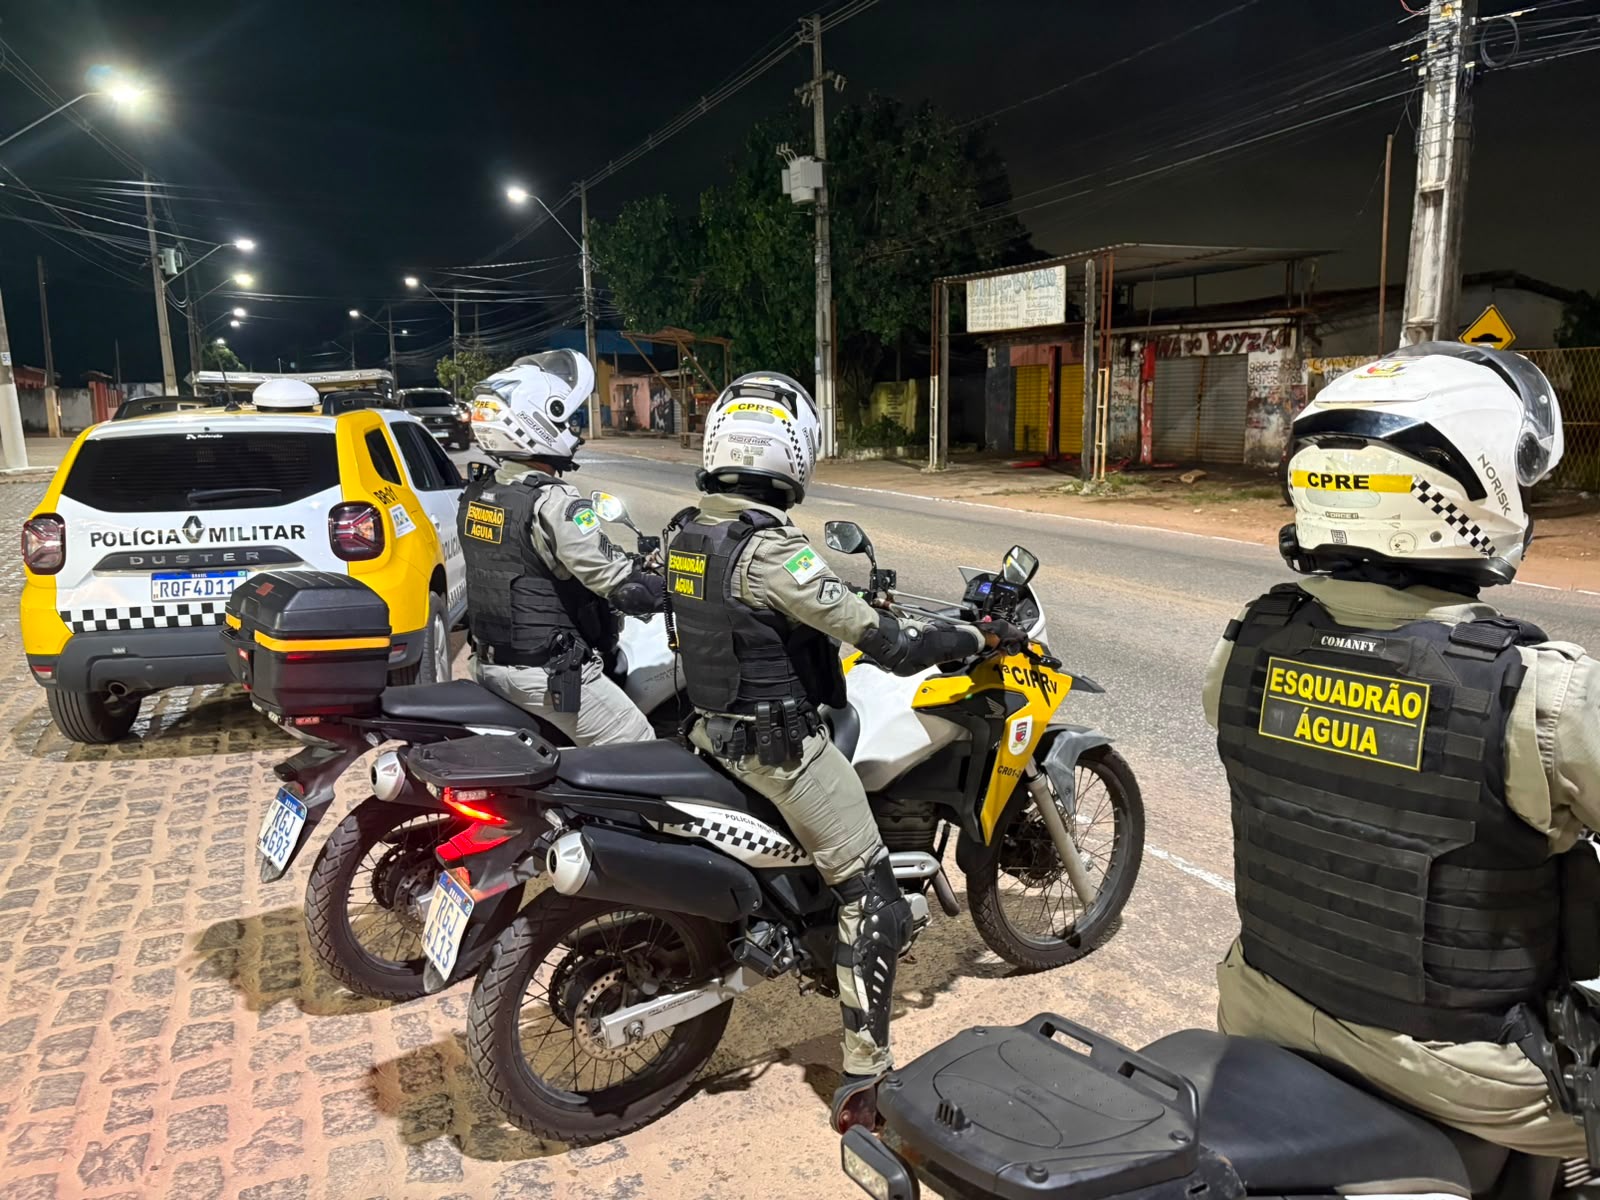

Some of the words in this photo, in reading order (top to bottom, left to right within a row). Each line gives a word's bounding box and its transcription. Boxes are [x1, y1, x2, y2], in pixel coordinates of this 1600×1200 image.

[474, 400, 489, 409] PRE
[738, 403, 774, 415] CPRE
[1307, 472, 1370, 490] CPRE
[1477, 454, 1511, 516] NORISK
[468, 505, 504, 525] ESQUADRÃO
[90, 527, 181, 547] POLÍCIA
[209, 524, 305, 542] MILITAR
[471, 523, 493, 540] ÁGUIA
[130, 552, 260, 565] DUSTER
[669, 555, 704, 574] ESQUADRÃO
[160, 579, 235, 597] RQF4D11
[675, 574, 694, 595] ÁGUIA
[1321, 636, 1376, 652] COMANFY
[1269, 667, 1422, 720] ESQUADRÃO
[1294, 707, 1378, 755] ÁGUIA
[271, 805, 296, 837] RGJ
[262, 826, 290, 862] 4G93
[436, 895, 460, 937] RGJ
